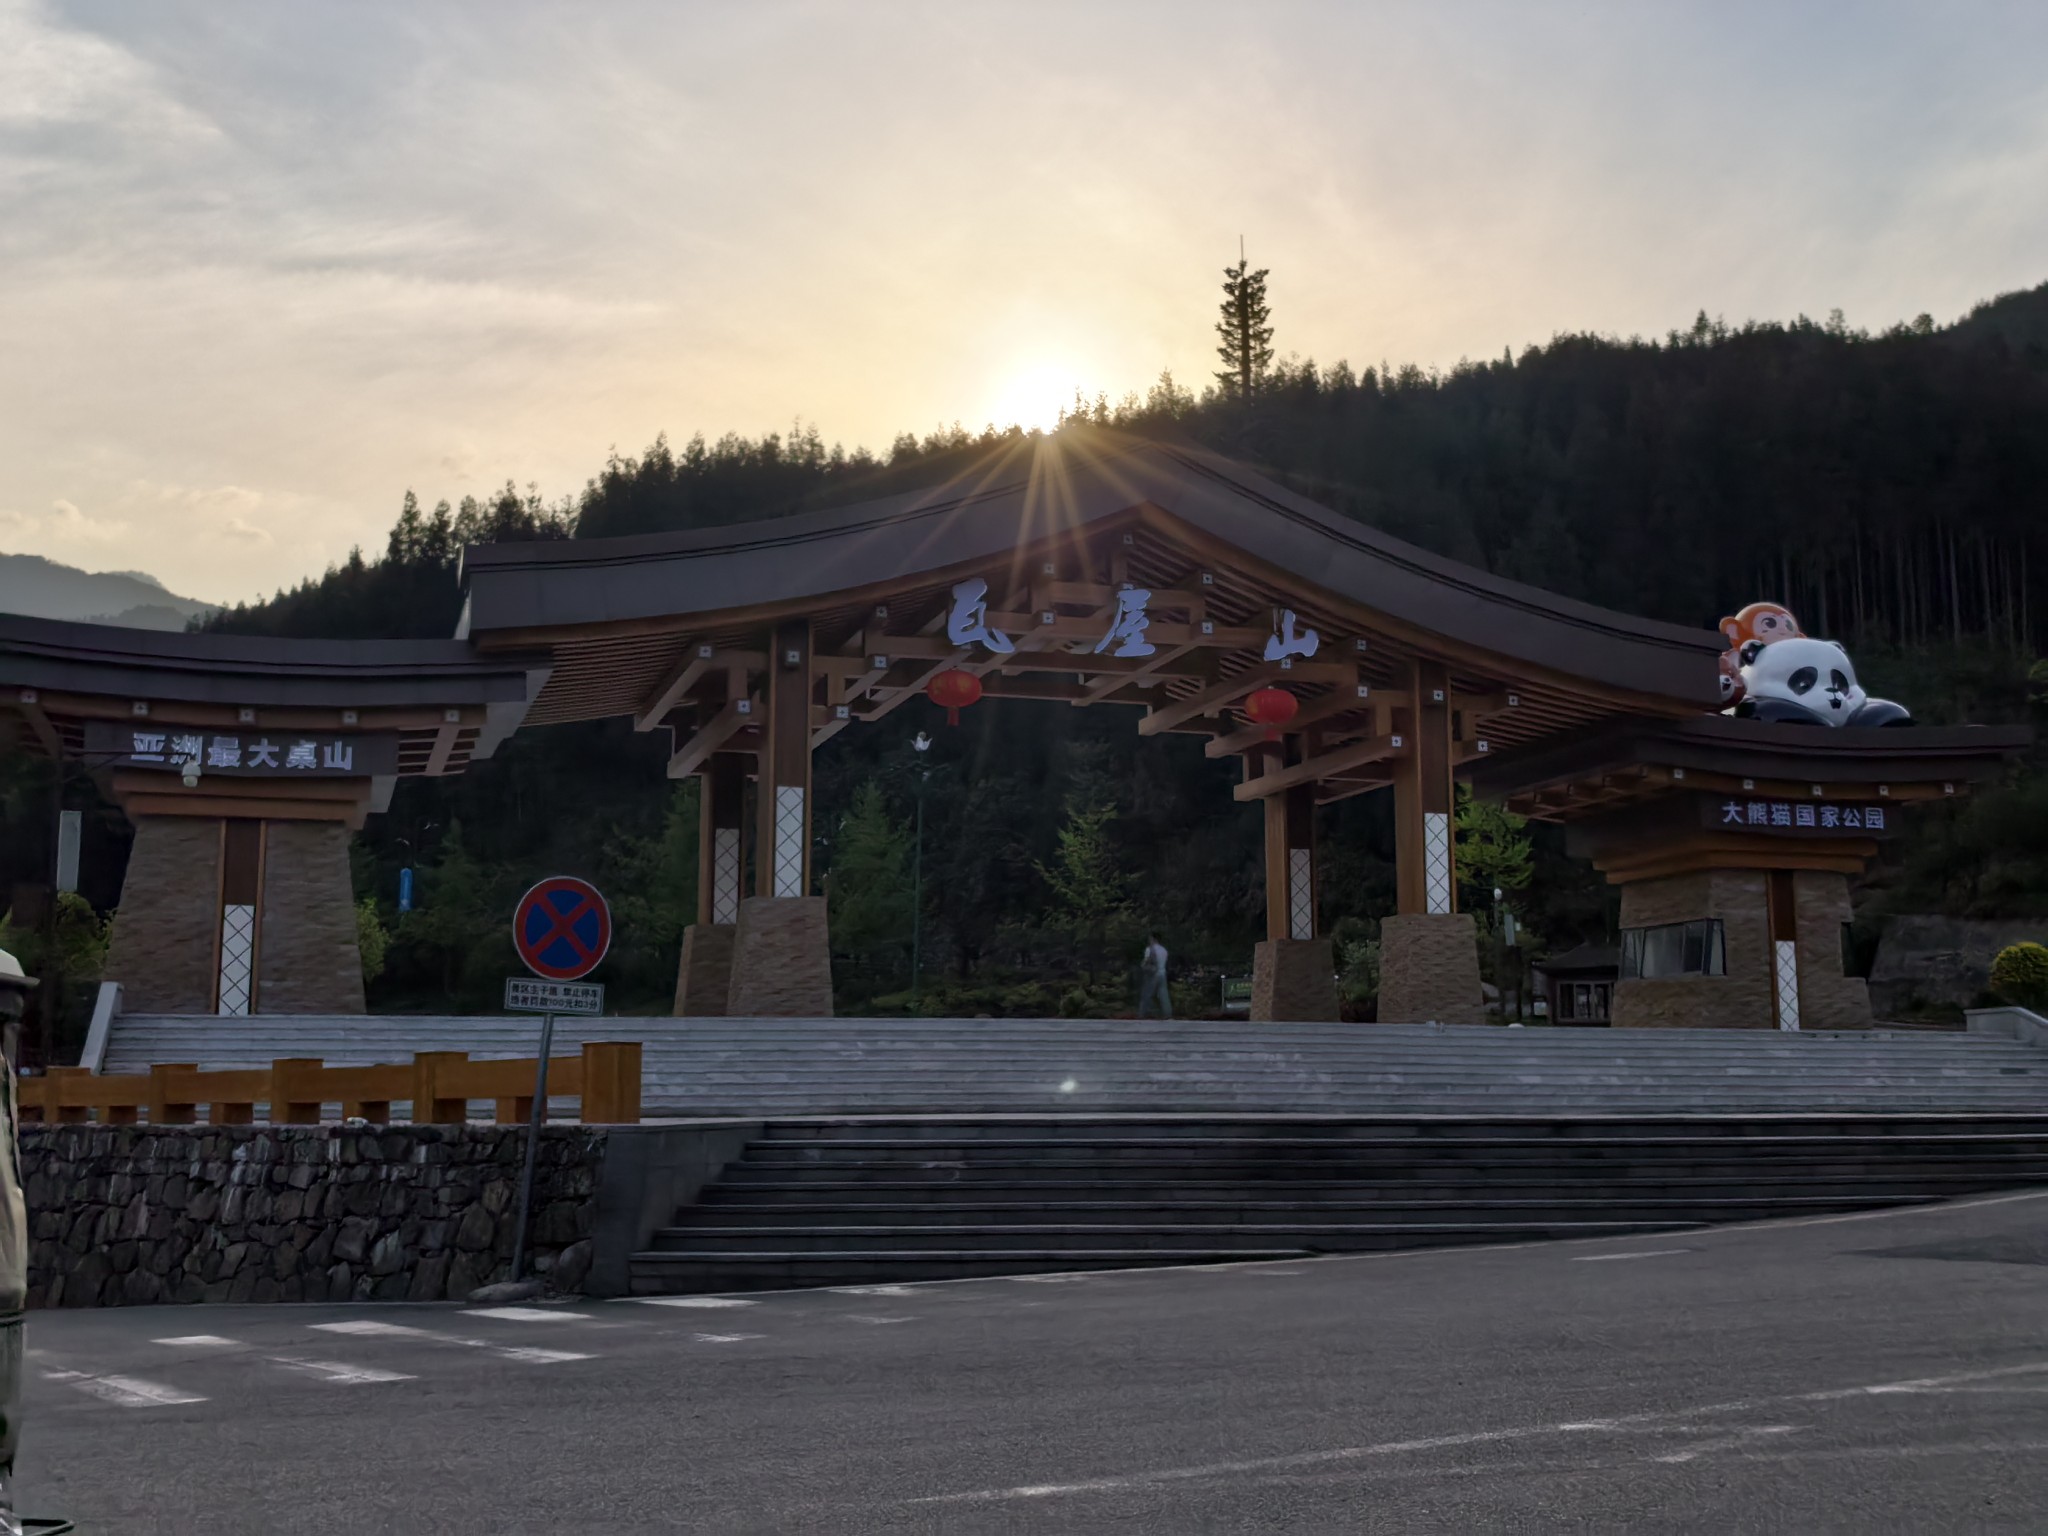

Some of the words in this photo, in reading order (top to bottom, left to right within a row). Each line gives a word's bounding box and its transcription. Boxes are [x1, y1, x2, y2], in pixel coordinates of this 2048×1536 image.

[947, 578, 1320, 661] 瓦屋山
[131, 732, 353, 771] 亚洲最大桌山
[1721, 801, 1884, 830] 大熊猫国家公园
[563, 987, 597, 998] 禁止停车
